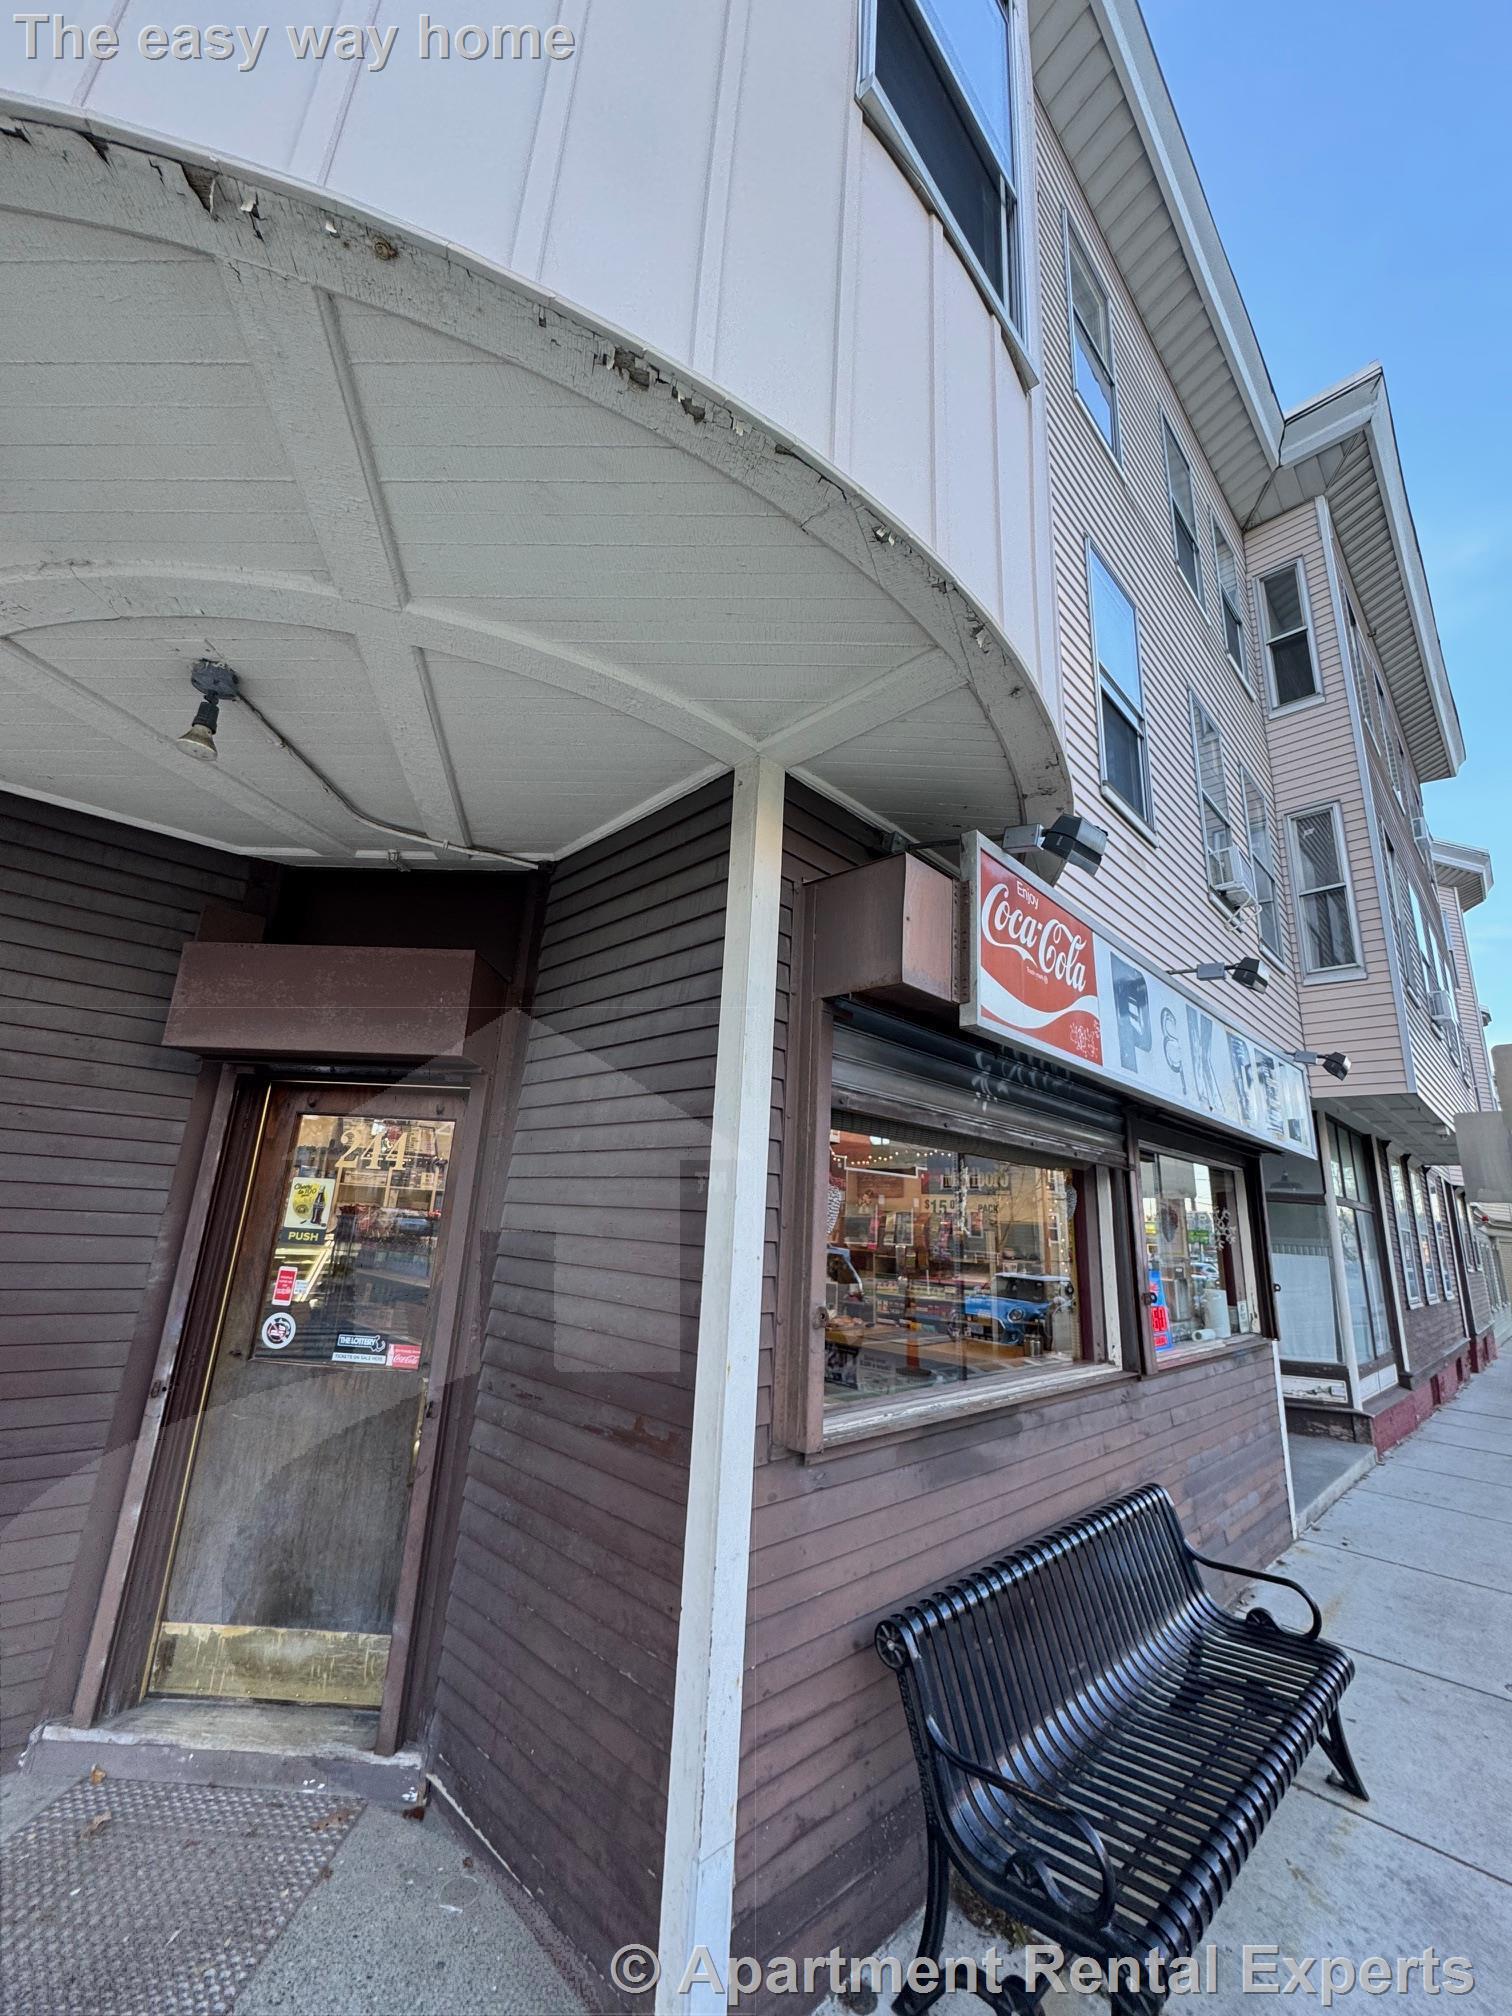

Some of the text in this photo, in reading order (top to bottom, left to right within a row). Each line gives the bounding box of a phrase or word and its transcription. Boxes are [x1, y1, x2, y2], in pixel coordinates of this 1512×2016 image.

[1016, 880, 1039, 910] Enjoy
[981, 883, 1087, 993] Coca-Cola
[335, 1129, 408, 1170] 244
[978, 1204, 998, 1214] PACK
[288, 1231, 319, 1241] PUSH
[340, 1336, 376, 1346] THE LOTTERY
